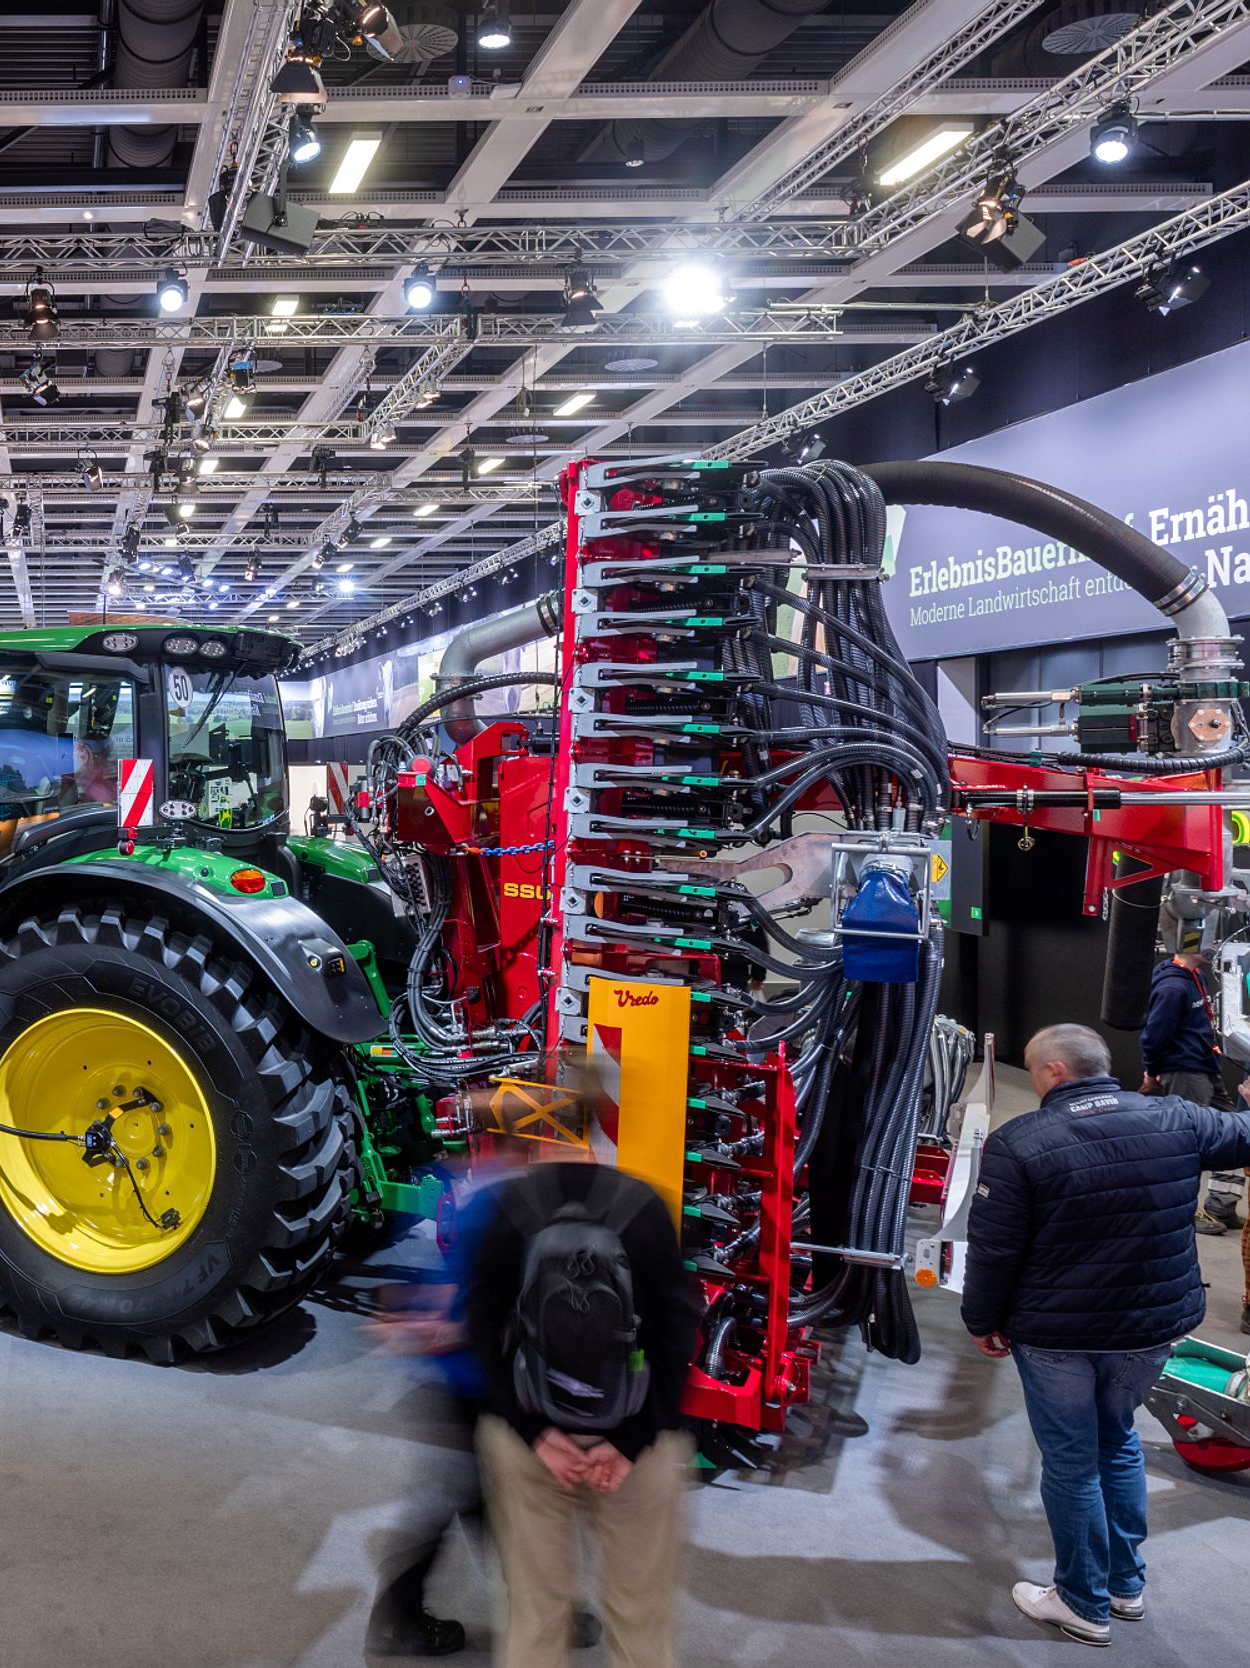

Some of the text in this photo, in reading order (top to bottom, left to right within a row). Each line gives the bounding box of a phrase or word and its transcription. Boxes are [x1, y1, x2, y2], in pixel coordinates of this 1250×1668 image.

[1149, 488, 1250, 546] Ernäh
[910, 602, 965, 627] Moderne
[968, 576, 1081, 617] Landwirtschaft
[173, 675, 189, 700] 50
[614, 989, 660, 1007] Vredo
[1070, 1102, 1093, 1112] CAMP
[1094, 1098, 1119, 1108] DAVID
